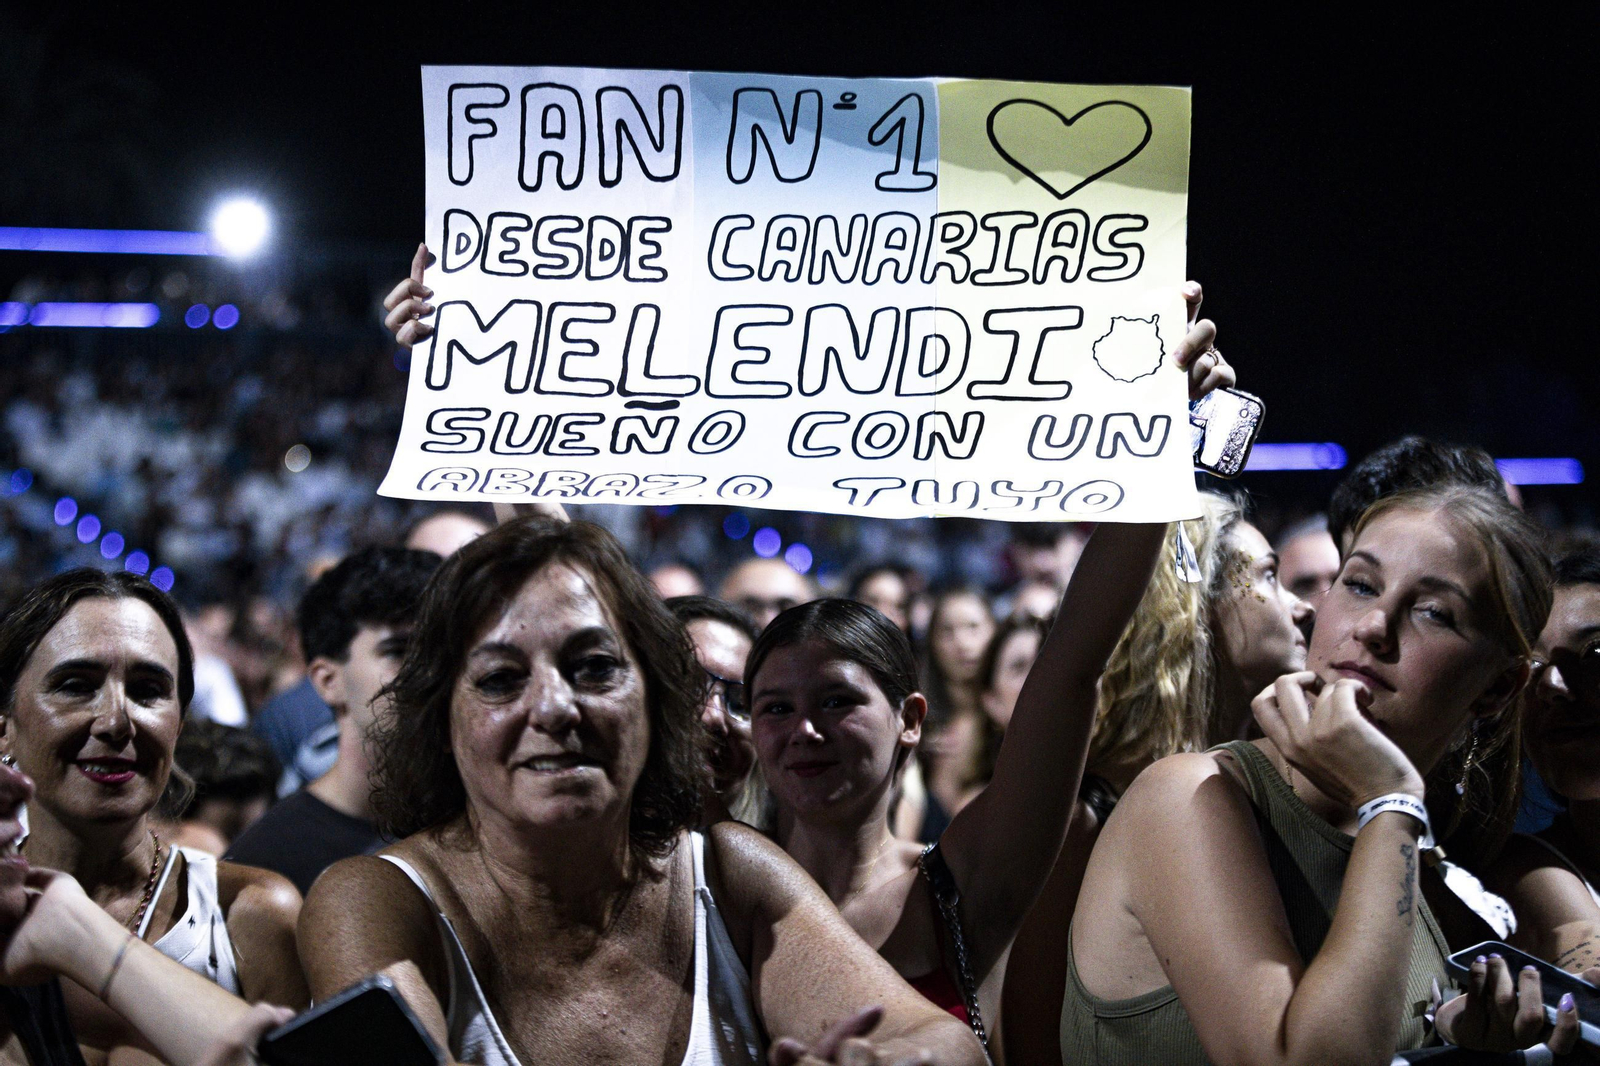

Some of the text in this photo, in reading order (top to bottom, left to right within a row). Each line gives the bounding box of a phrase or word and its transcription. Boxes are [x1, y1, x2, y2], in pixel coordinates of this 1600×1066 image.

[447, 82, 684, 192] FAN
[868, 92, 938, 192] 1
[441, 208, 1149, 286] DESDE CANARIAS
[425, 299, 1084, 401] MELENDI
[420, 400, 1172, 461] SUEÑO CON UN
[416, 466, 1125, 514] ABRAZO TUYO
